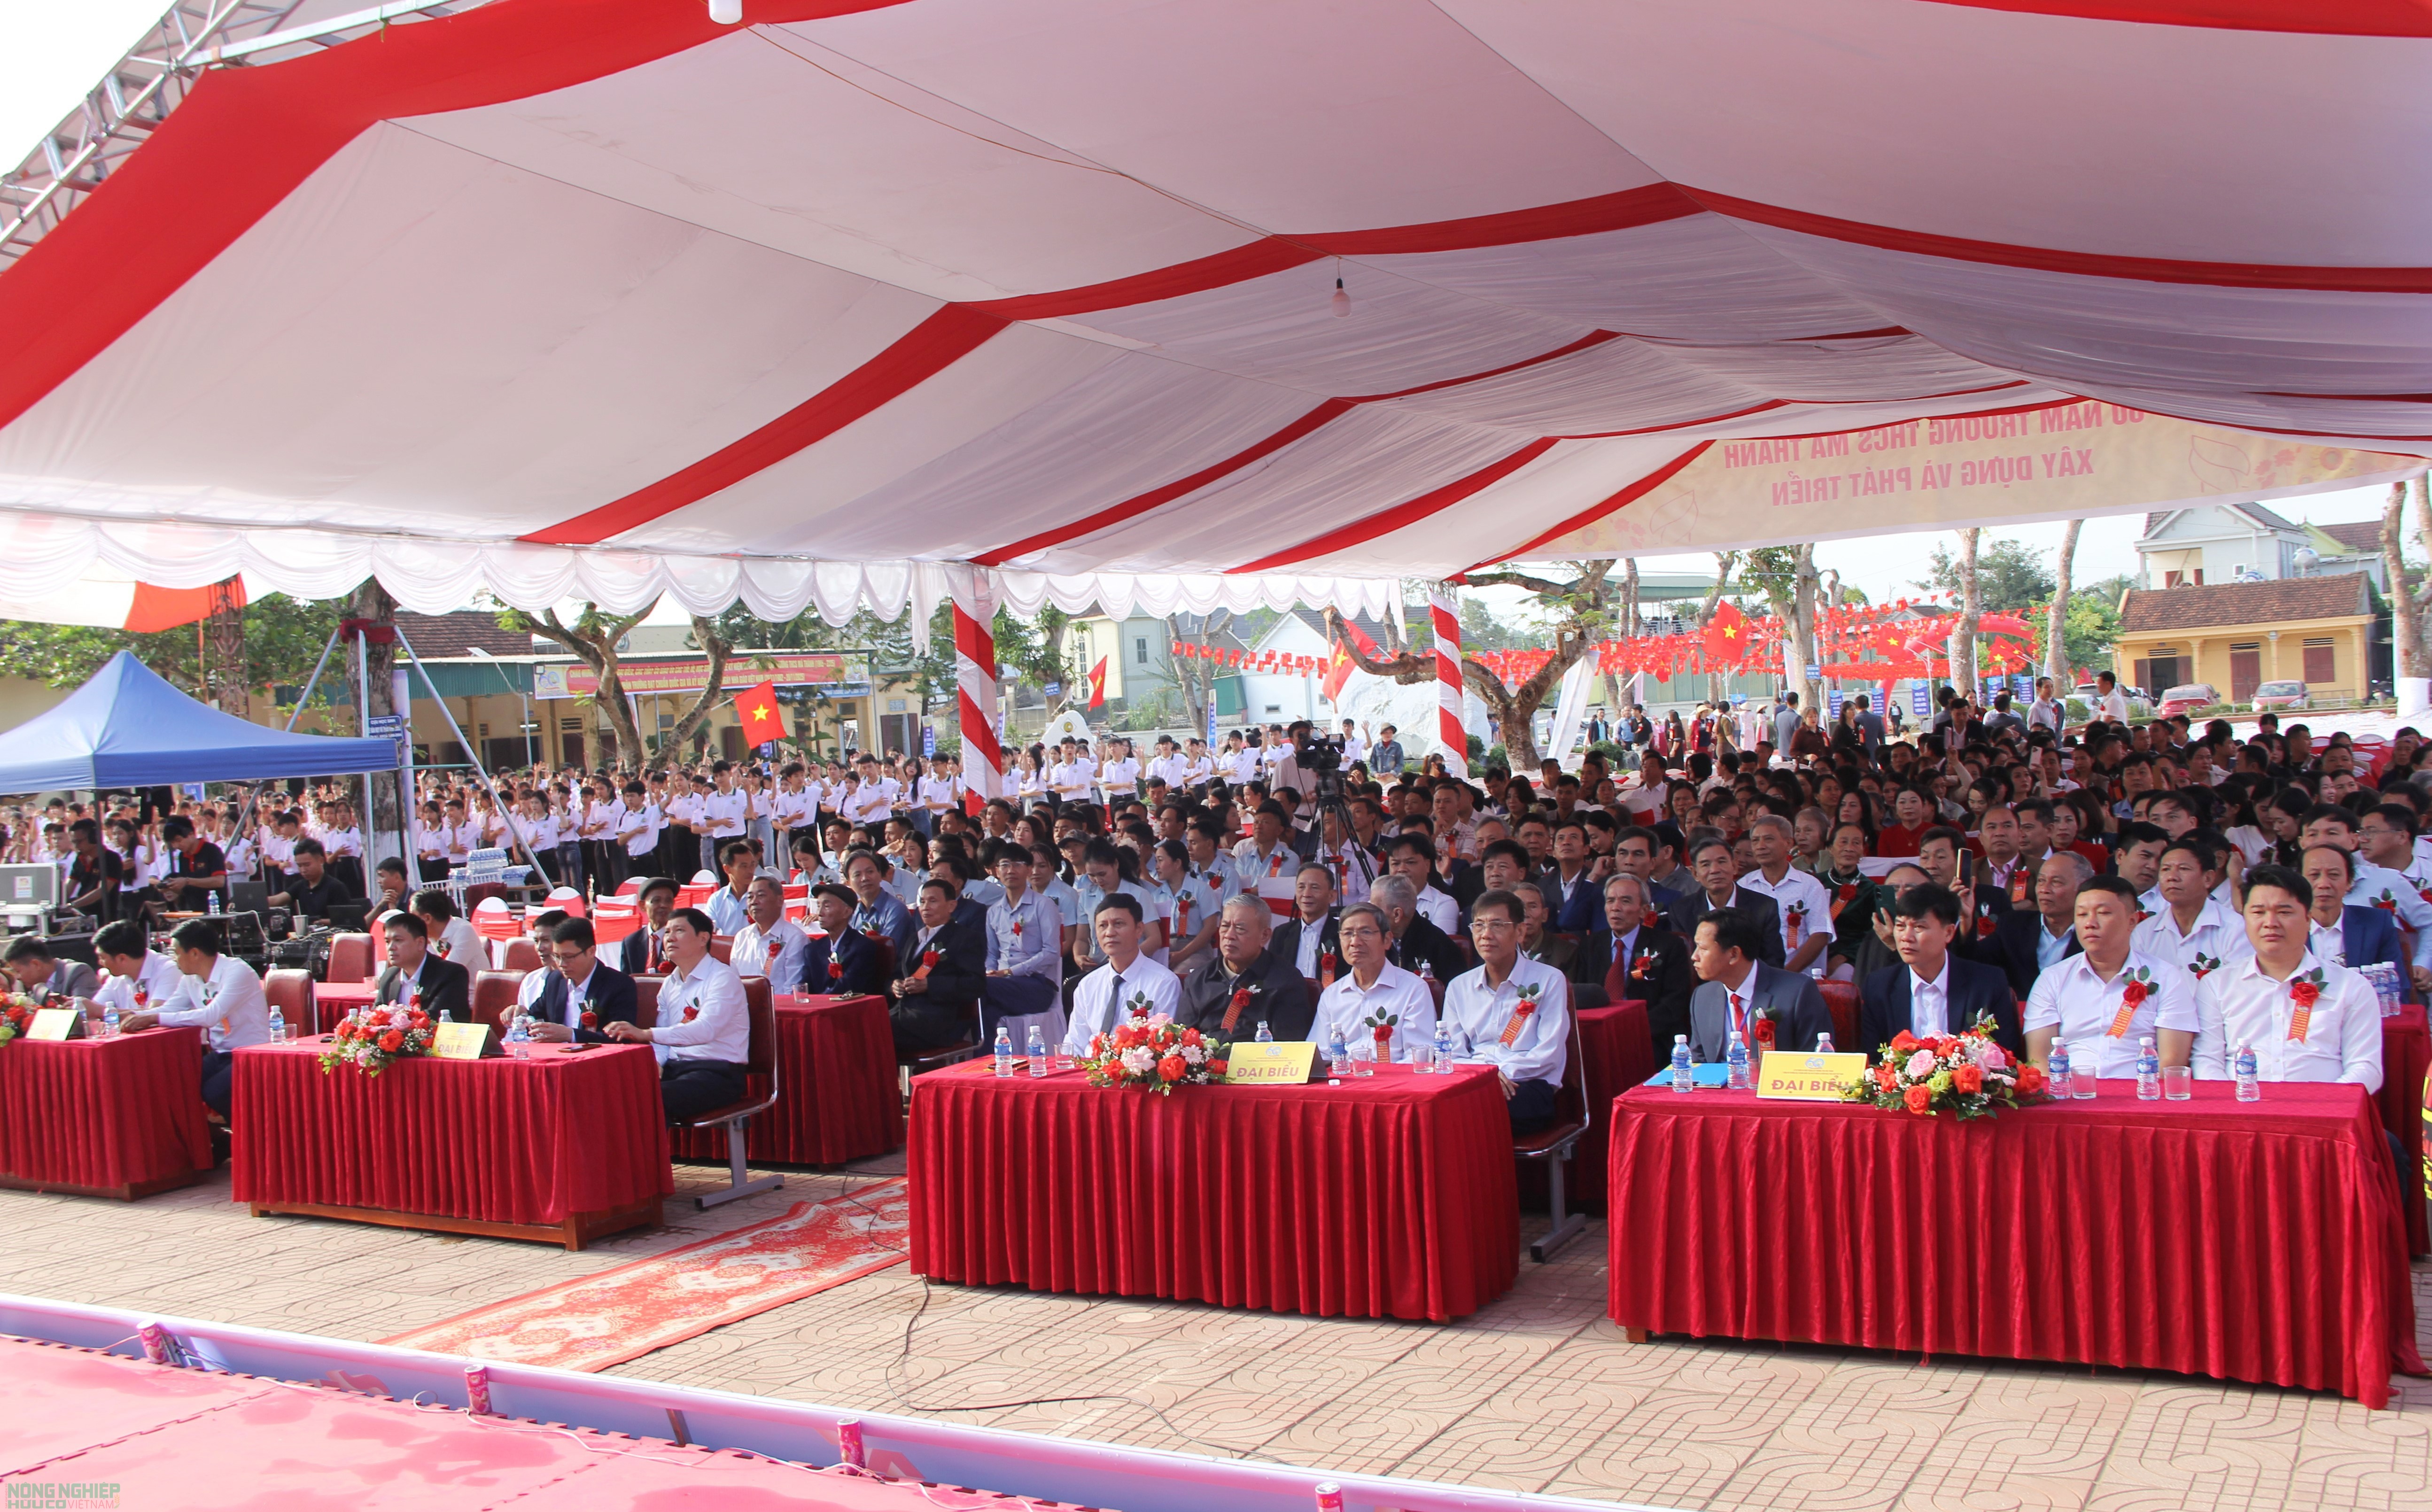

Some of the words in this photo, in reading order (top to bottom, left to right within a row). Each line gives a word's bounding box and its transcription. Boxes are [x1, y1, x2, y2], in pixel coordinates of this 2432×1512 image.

[438, 1044, 454, 1055] ĐẠI
[1236, 1067, 1263, 1080] ĐẠI
[1267, 1062, 1299, 1077] BIỂU
[1772, 1079, 1803, 1093] ĐẠI
